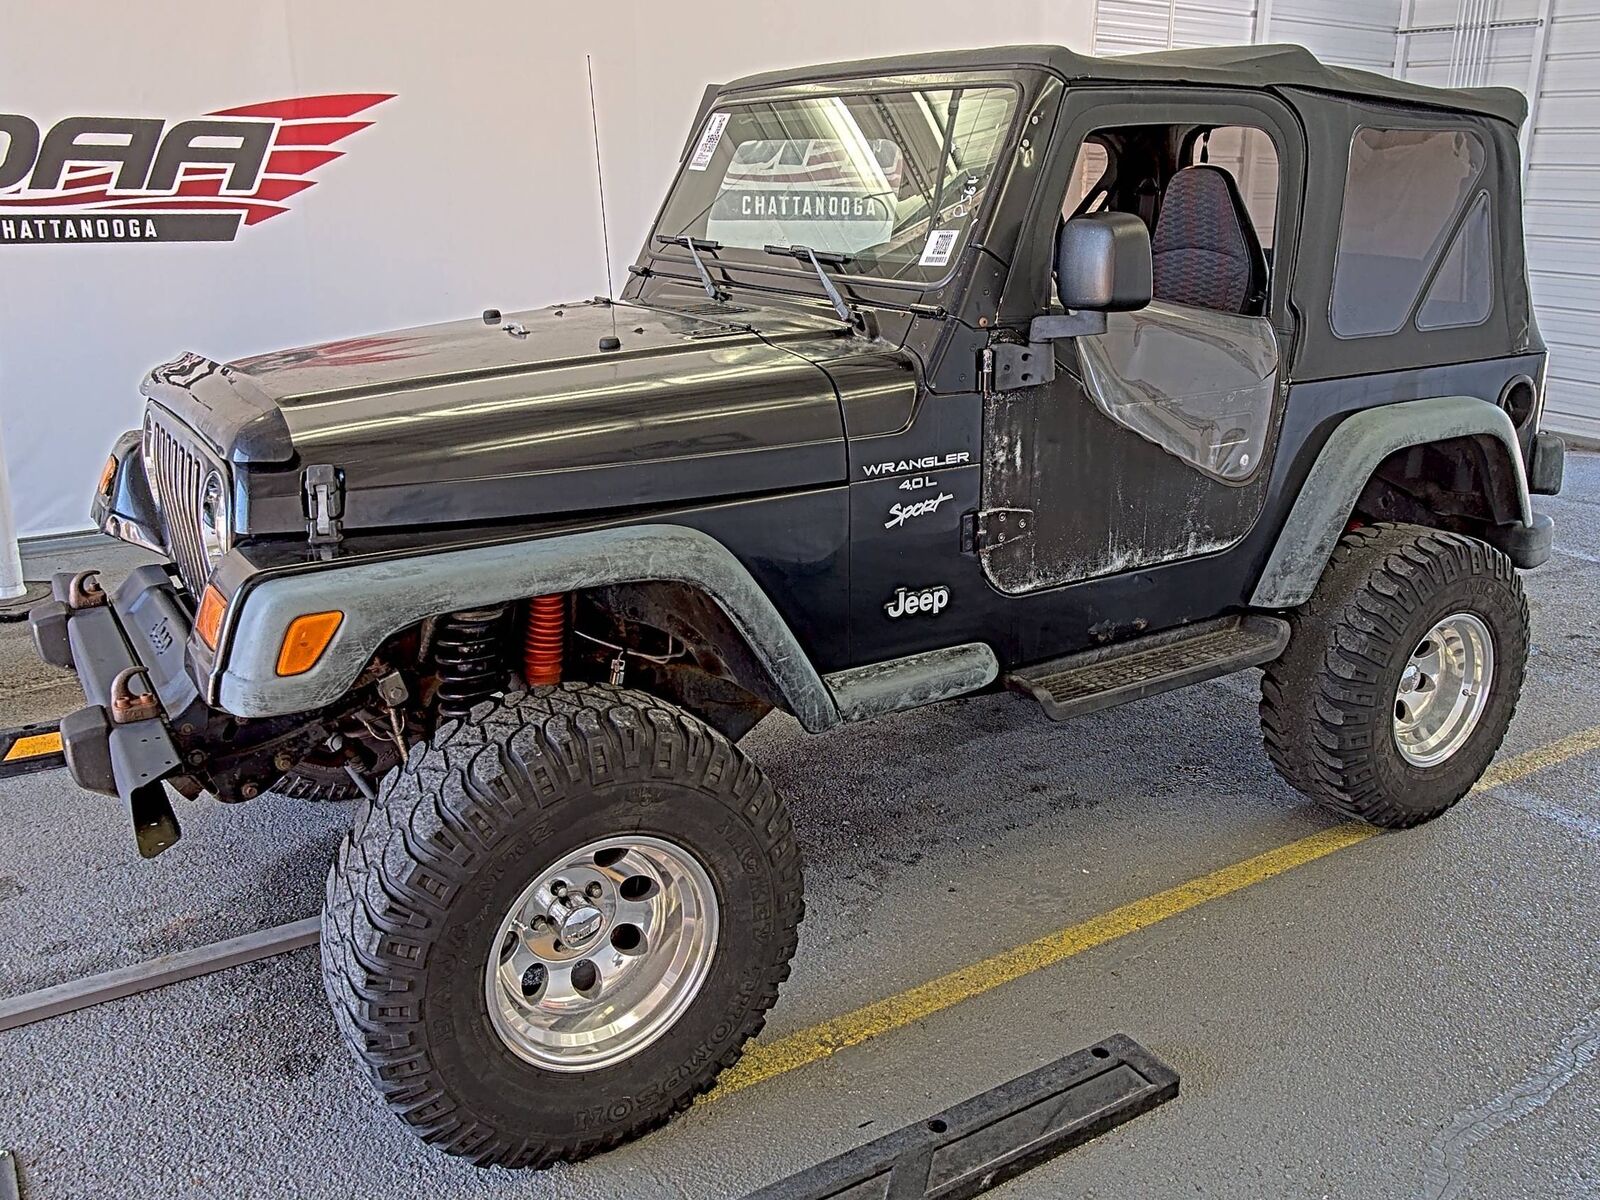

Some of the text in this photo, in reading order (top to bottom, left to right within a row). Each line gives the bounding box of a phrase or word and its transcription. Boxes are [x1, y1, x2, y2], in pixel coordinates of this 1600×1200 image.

[741, 195, 876, 217] CHATTANOOGA
[0, 218, 158, 240] HATTANOOGA
[862, 451, 970, 477] WRANGLER
[884, 492, 954, 529] Sport
[884, 586, 950, 618] Jeep
